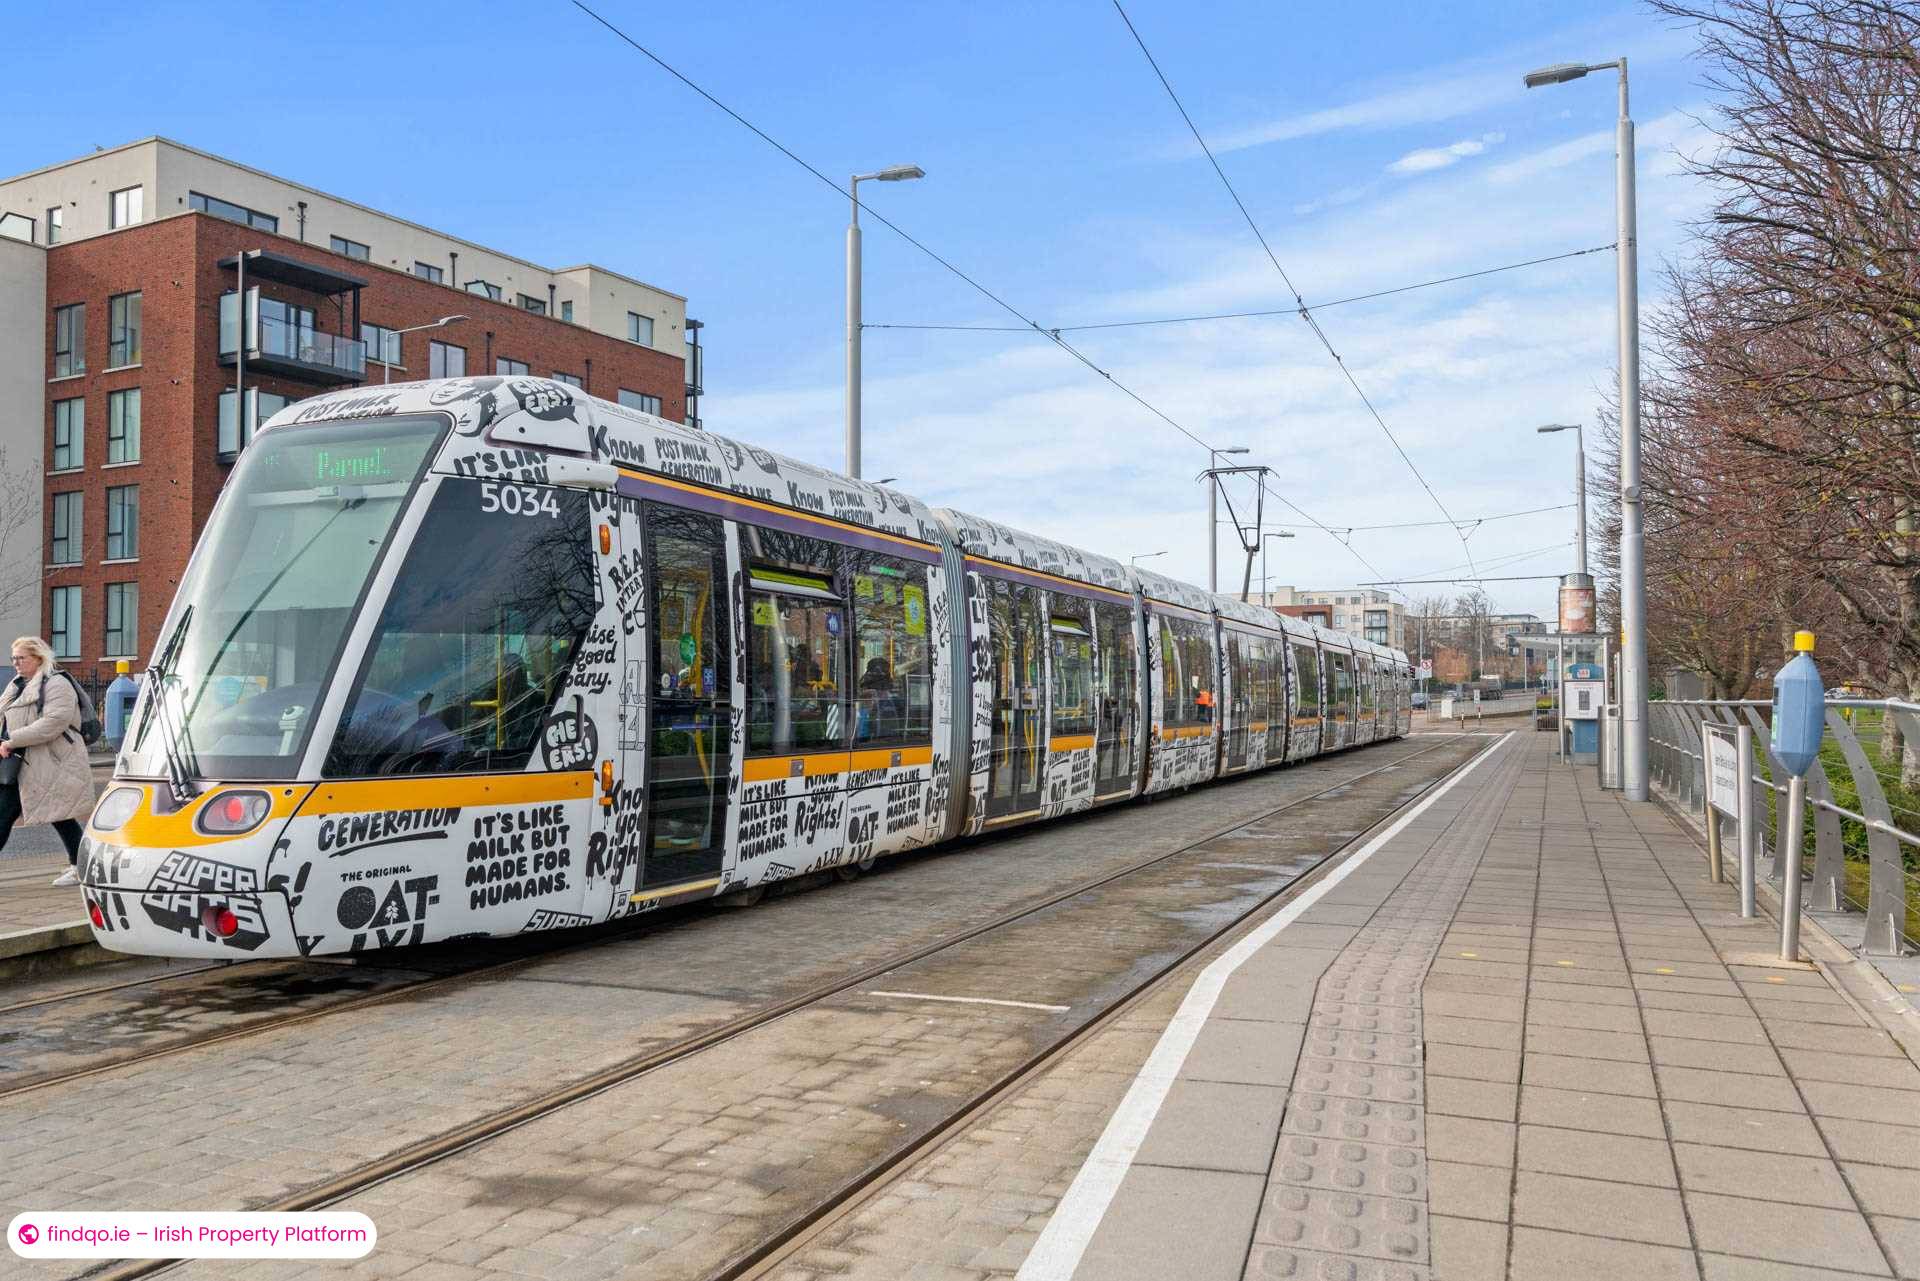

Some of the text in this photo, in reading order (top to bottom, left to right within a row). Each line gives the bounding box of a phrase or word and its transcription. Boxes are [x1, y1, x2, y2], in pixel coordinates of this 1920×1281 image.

[588, 425, 646, 464] Know
[655, 437, 711, 462] POST MILK
[314, 448, 392, 480] Parnel
[453, 452, 499, 477] IT'S
[481, 483, 560, 518] 5034
[787, 480, 824, 511] Know
[744, 784, 763, 802] IT'S
[764, 779, 787, 799] LIKE
[888, 782, 921, 805] MILK BUT
[890, 768, 920, 788] IT'S LIKE
[602, 779, 642, 817] Kno
[740, 798, 788, 825] MILK BUT
[886, 796, 920, 820] MADE FOR
[318, 806, 461, 851] GENERATION
[474, 804, 565, 839] IT'S LIKE
[738, 813, 788, 844] MADE FOR
[794, 800, 844, 846] Rights!
[887, 812, 919, 835] HUMANS.
[467, 825, 571, 863] MILK BUT
[740, 833, 788, 863] HUMANS.
[341, 864, 412, 882] THE ORIGINAL
[465, 847, 571, 888] MADE FOR
[469, 872, 570, 911] HUMANS.
